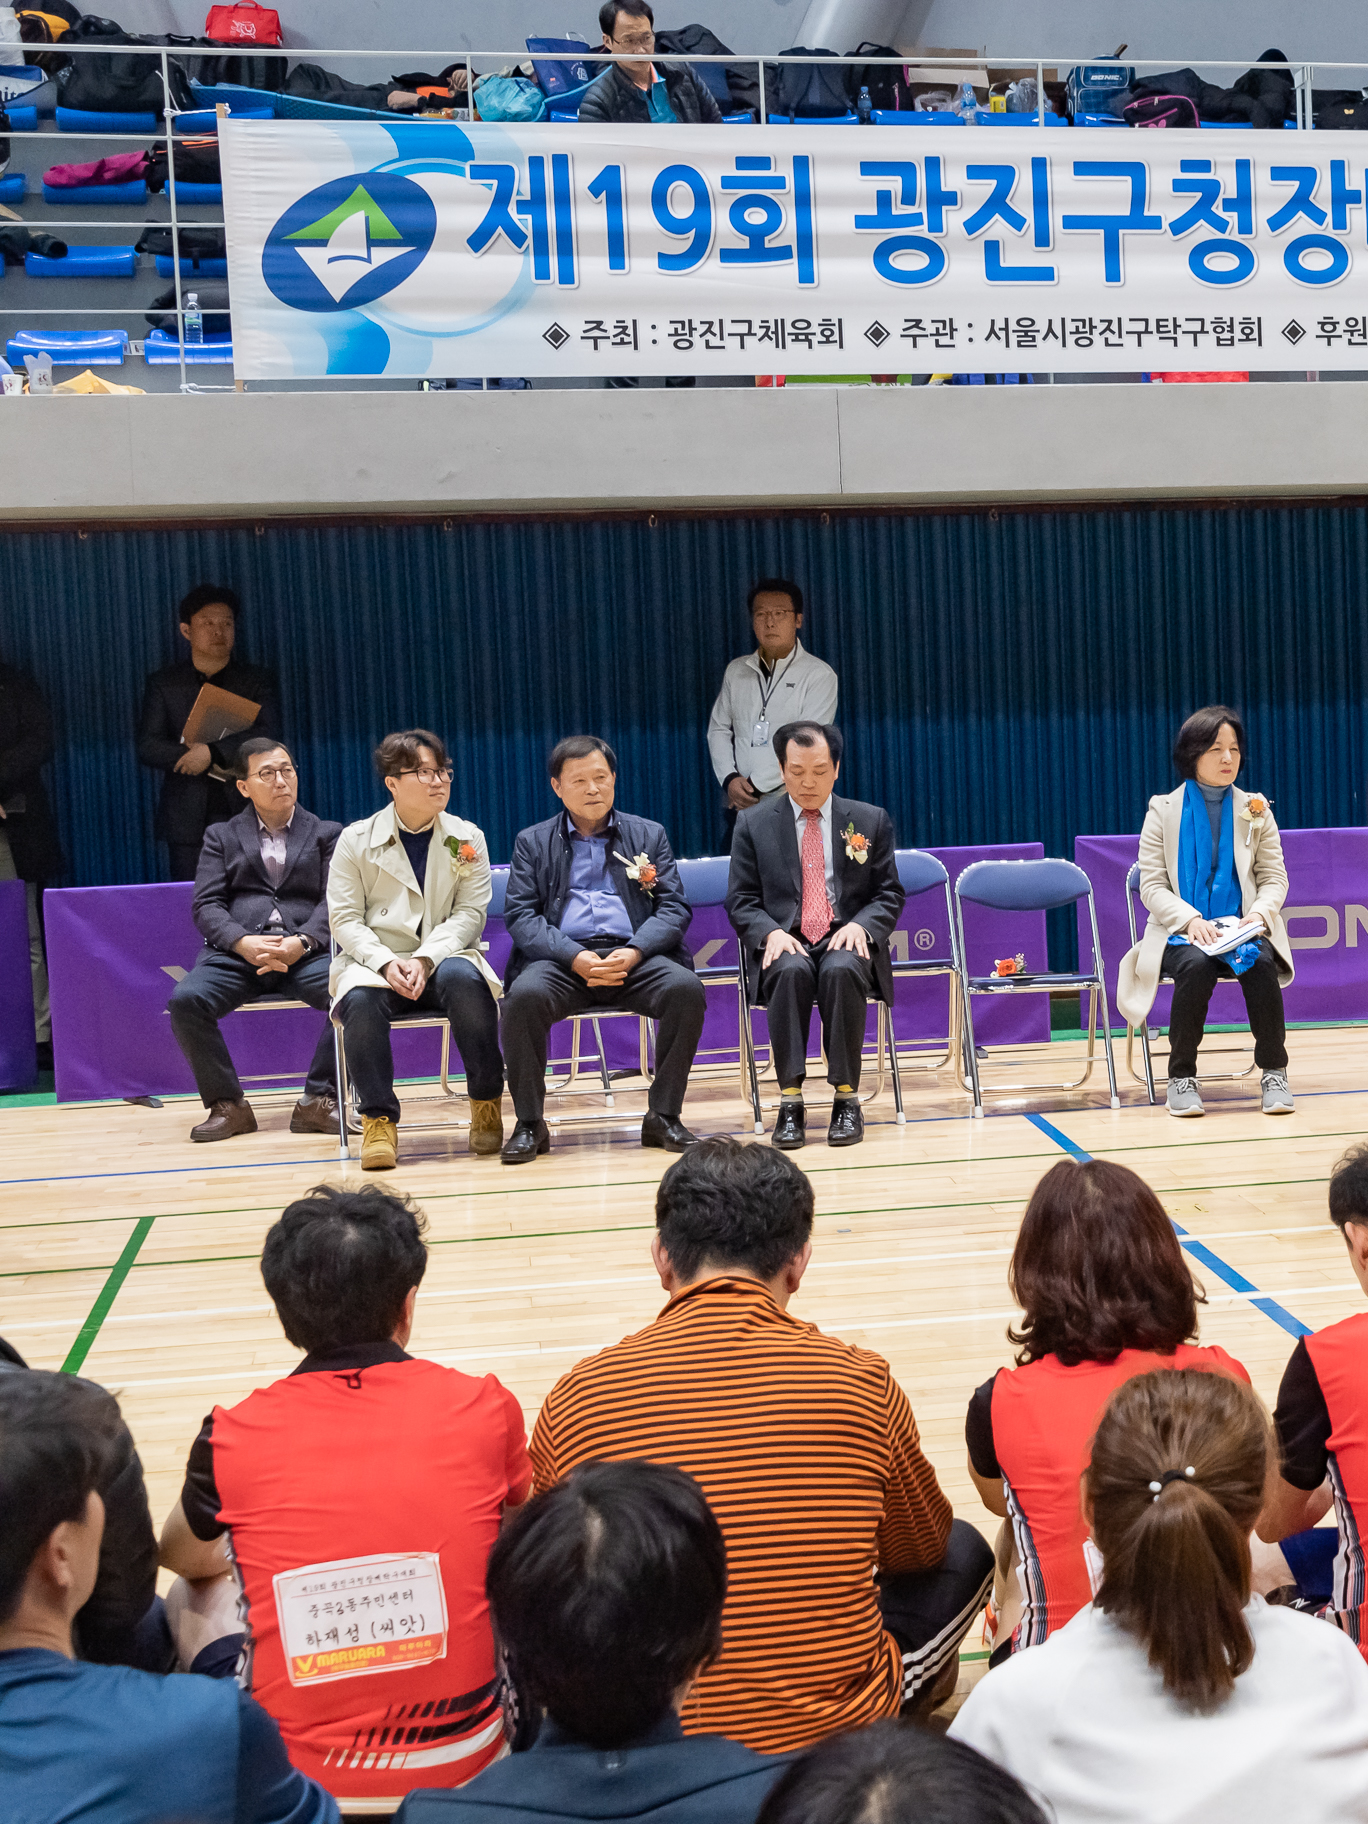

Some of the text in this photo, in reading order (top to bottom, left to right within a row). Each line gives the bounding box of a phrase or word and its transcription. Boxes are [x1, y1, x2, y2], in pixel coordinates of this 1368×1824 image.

[469, 154, 816, 286] 제19회
[580, 319, 640, 351] 주최
[667, 318, 844, 351] 광진구체육회
[900, 317, 958, 349] 주관
[984, 316, 1263, 349] 서울시광진구탁구협회
[1315, 316, 1368, 347] 후원
[316, 1644, 386, 1668] MARUARA
